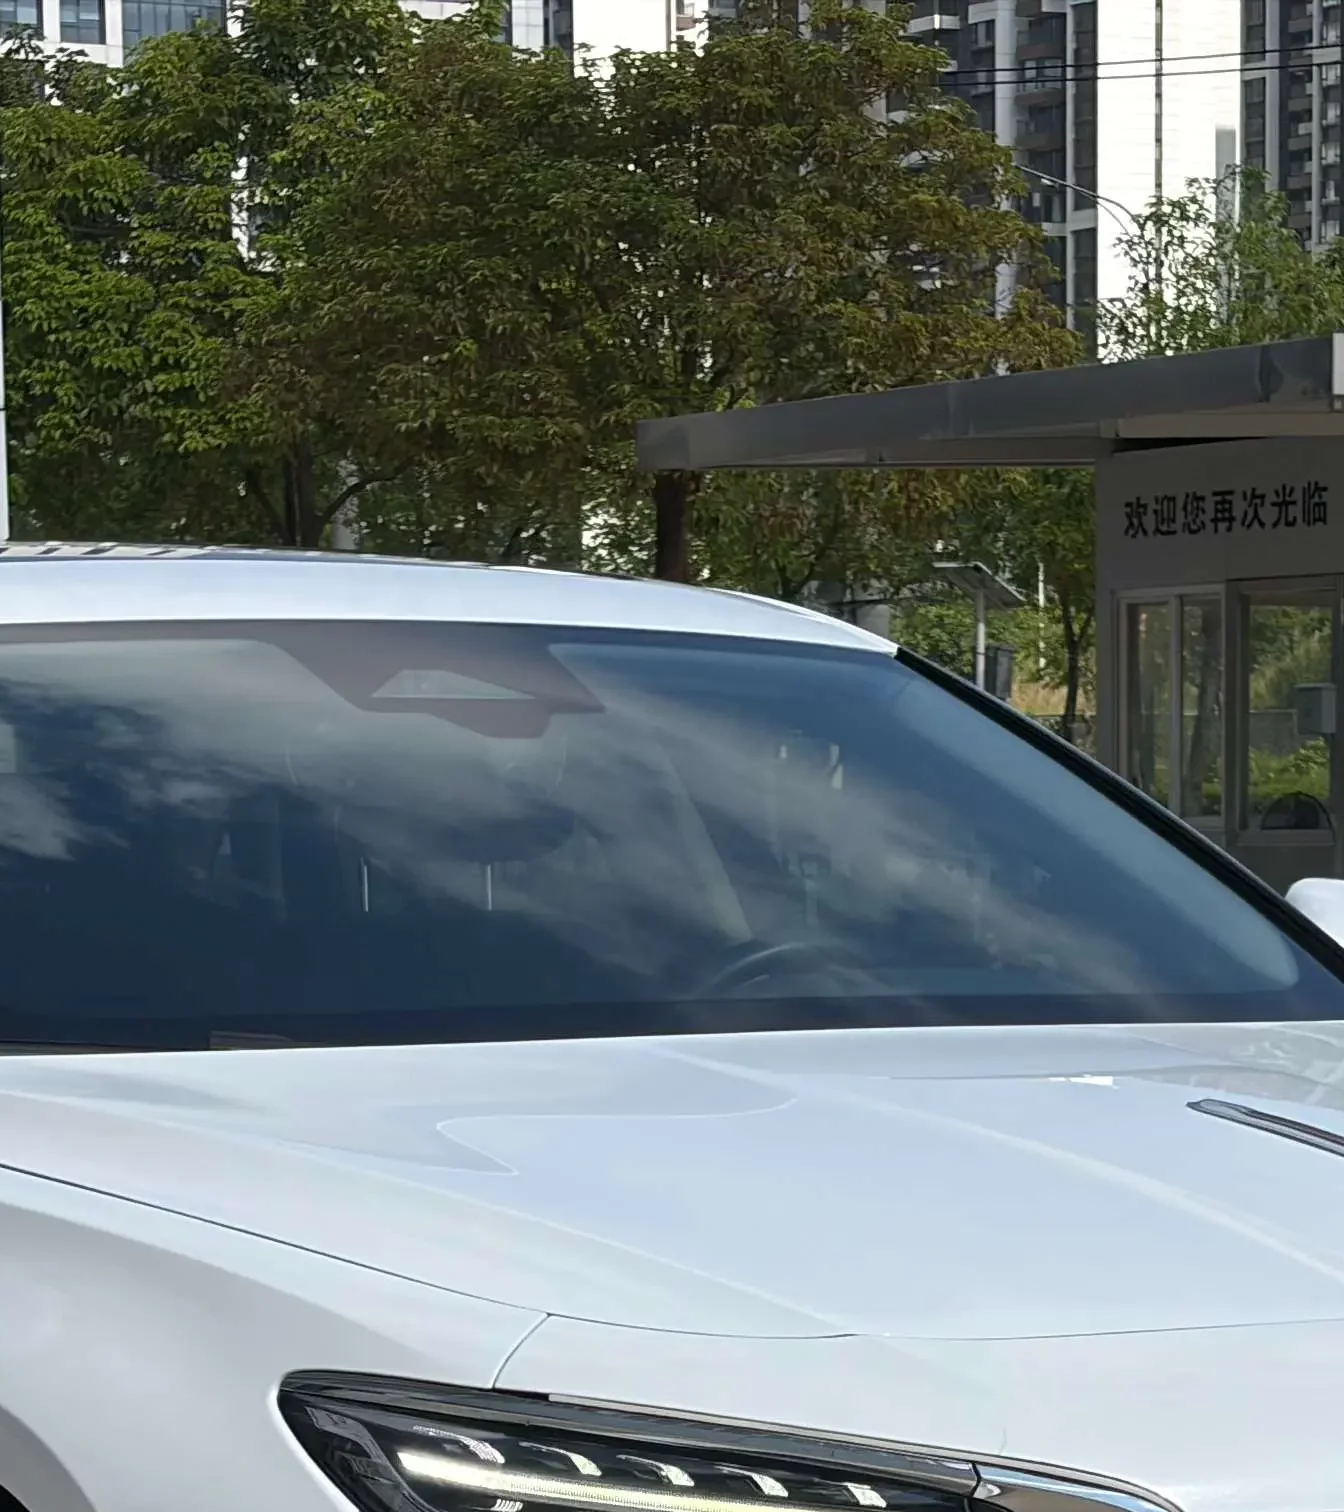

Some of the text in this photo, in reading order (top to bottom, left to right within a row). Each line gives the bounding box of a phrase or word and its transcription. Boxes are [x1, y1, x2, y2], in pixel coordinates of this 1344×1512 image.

[1123, 481, 1329, 538] 欢迎您再次光临
